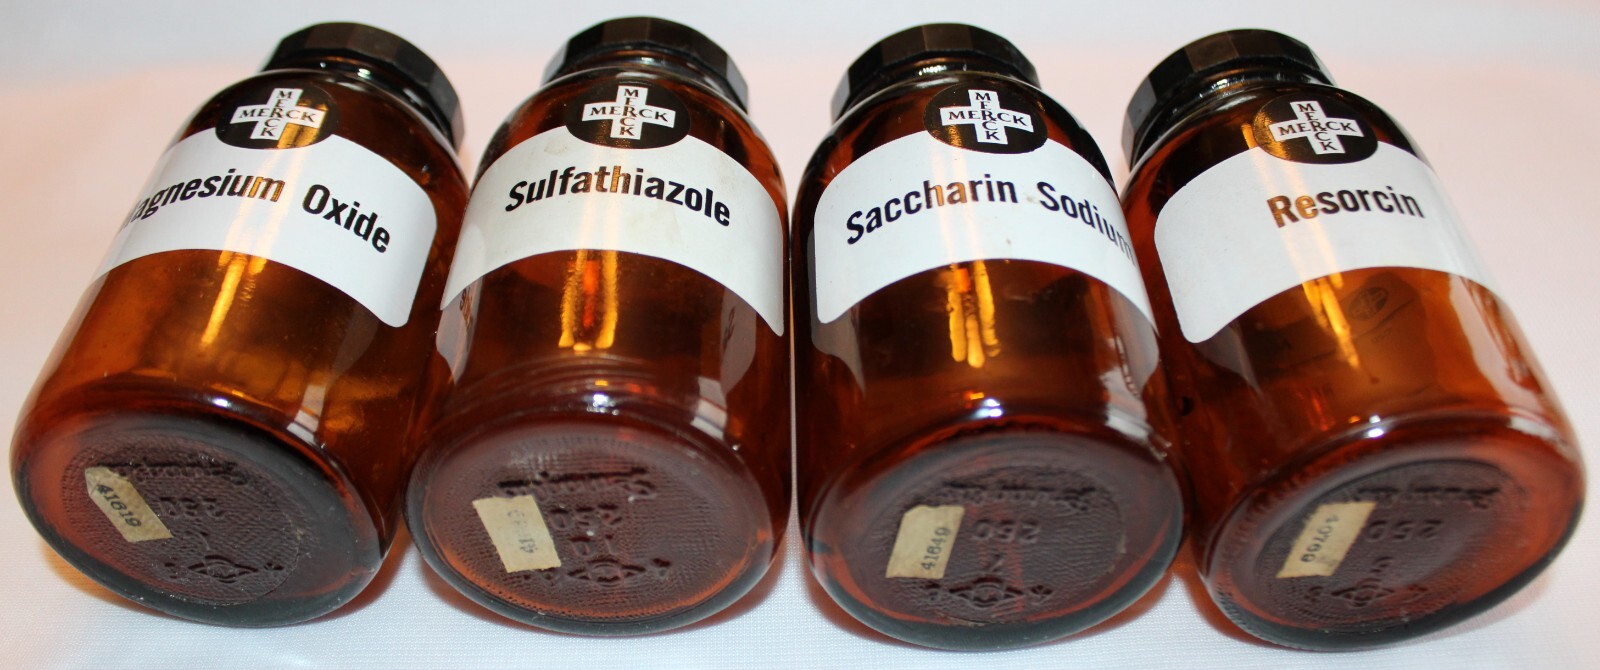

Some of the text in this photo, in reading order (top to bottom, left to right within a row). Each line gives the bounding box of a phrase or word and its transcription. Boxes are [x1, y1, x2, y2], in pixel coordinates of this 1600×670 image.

[239, 107, 316, 123] MERCK
[260, 90, 292, 137] MERCK
[589, 105, 669, 123] MERCK
[617, 87, 639, 137] MERCK
[948, 110, 1028, 127] MERCK
[974, 92, 1001, 141] MERCK
[1278, 120, 1357, 137] MERCK
[1297, 103, 1338, 151] MERCK
[302, 184, 391, 254] Oxide
[504, 165, 731, 227] Sulfathiazole
[1266, 185, 1427, 229] Resorcin
[846, 173, 1136, 267] Saccharin Sodium
